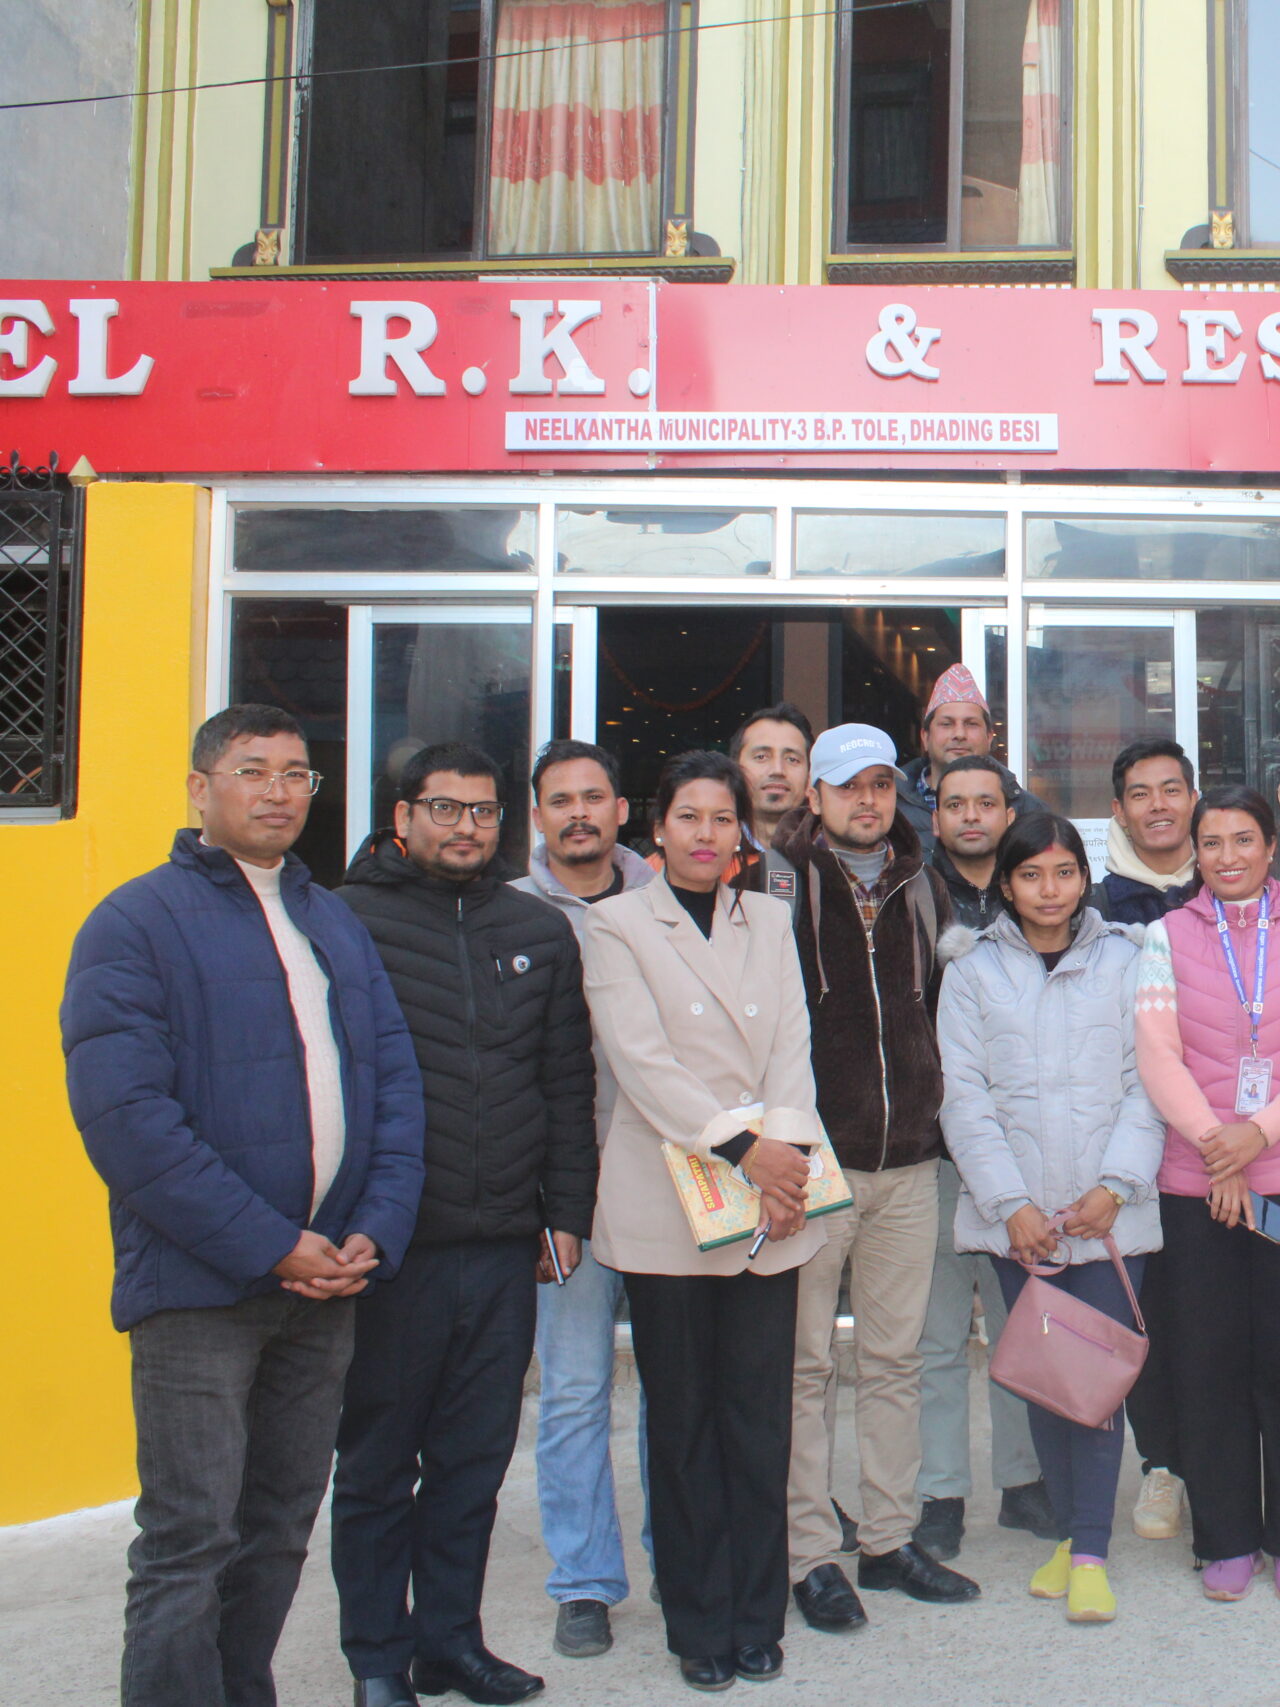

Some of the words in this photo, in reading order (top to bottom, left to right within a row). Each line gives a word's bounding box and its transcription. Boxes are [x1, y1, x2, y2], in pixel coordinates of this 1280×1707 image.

[866, 304, 941, 381] &
[525, 418, 652, 441] NEELKANTHA
[658, 418, 807, 442] MUNICIPALITY-3
[813, 419, 846, 442] B.P.
[851, 420, 907, 446] TOLE,
[910, 420, 994, 443] DHADING
[999, 420, 1040, 443] BESI
[689, 1157, 715, 1210] SAYAPATRI
